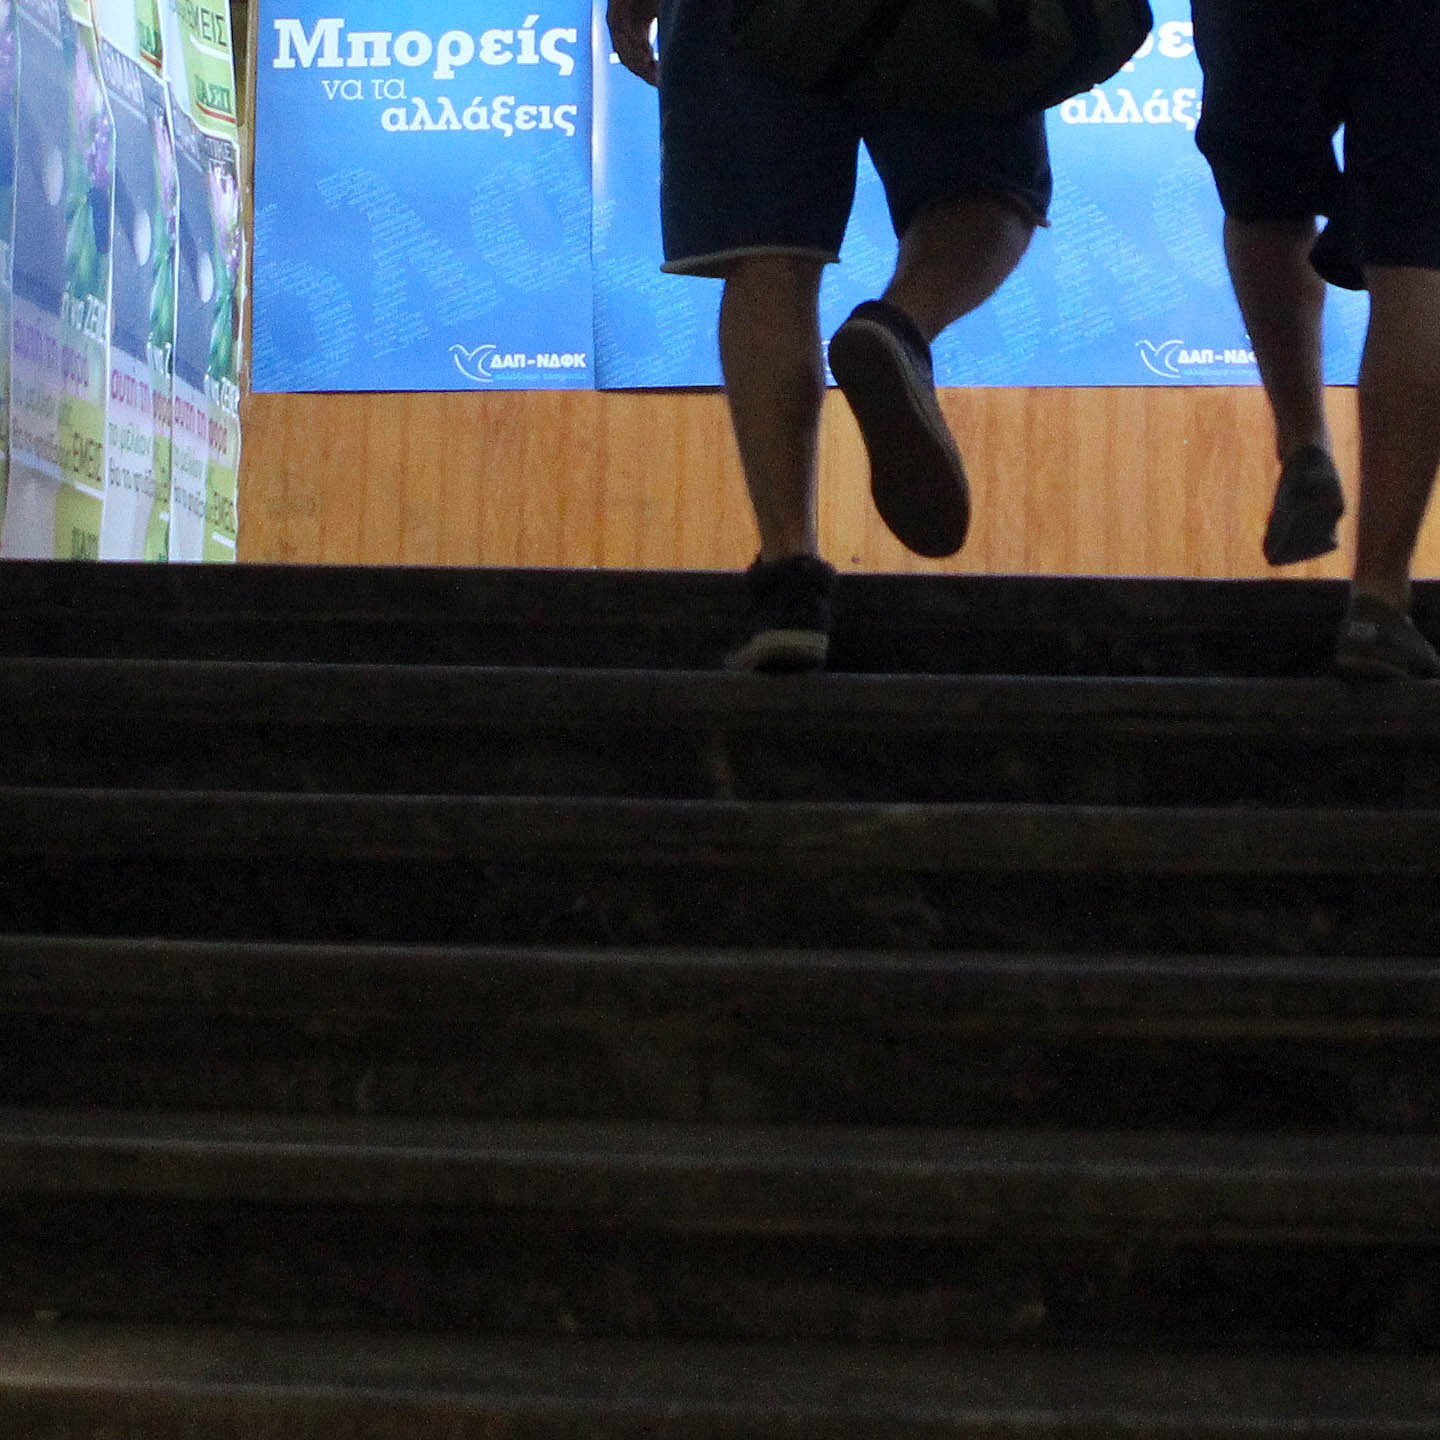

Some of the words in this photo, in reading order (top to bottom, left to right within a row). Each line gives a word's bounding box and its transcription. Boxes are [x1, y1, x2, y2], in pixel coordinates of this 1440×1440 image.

[272, 13, 578, 80] Μπορείς
[323, 79, 363, 101] να
[371, 77, 407, 100] τα
[1060, 87, 1202, 131] αλλάξ
[380, 95, 578, 138] αλλάξεις
[489, 351, 587, 369] ΔΑΠ-ΝΔΦΚ
